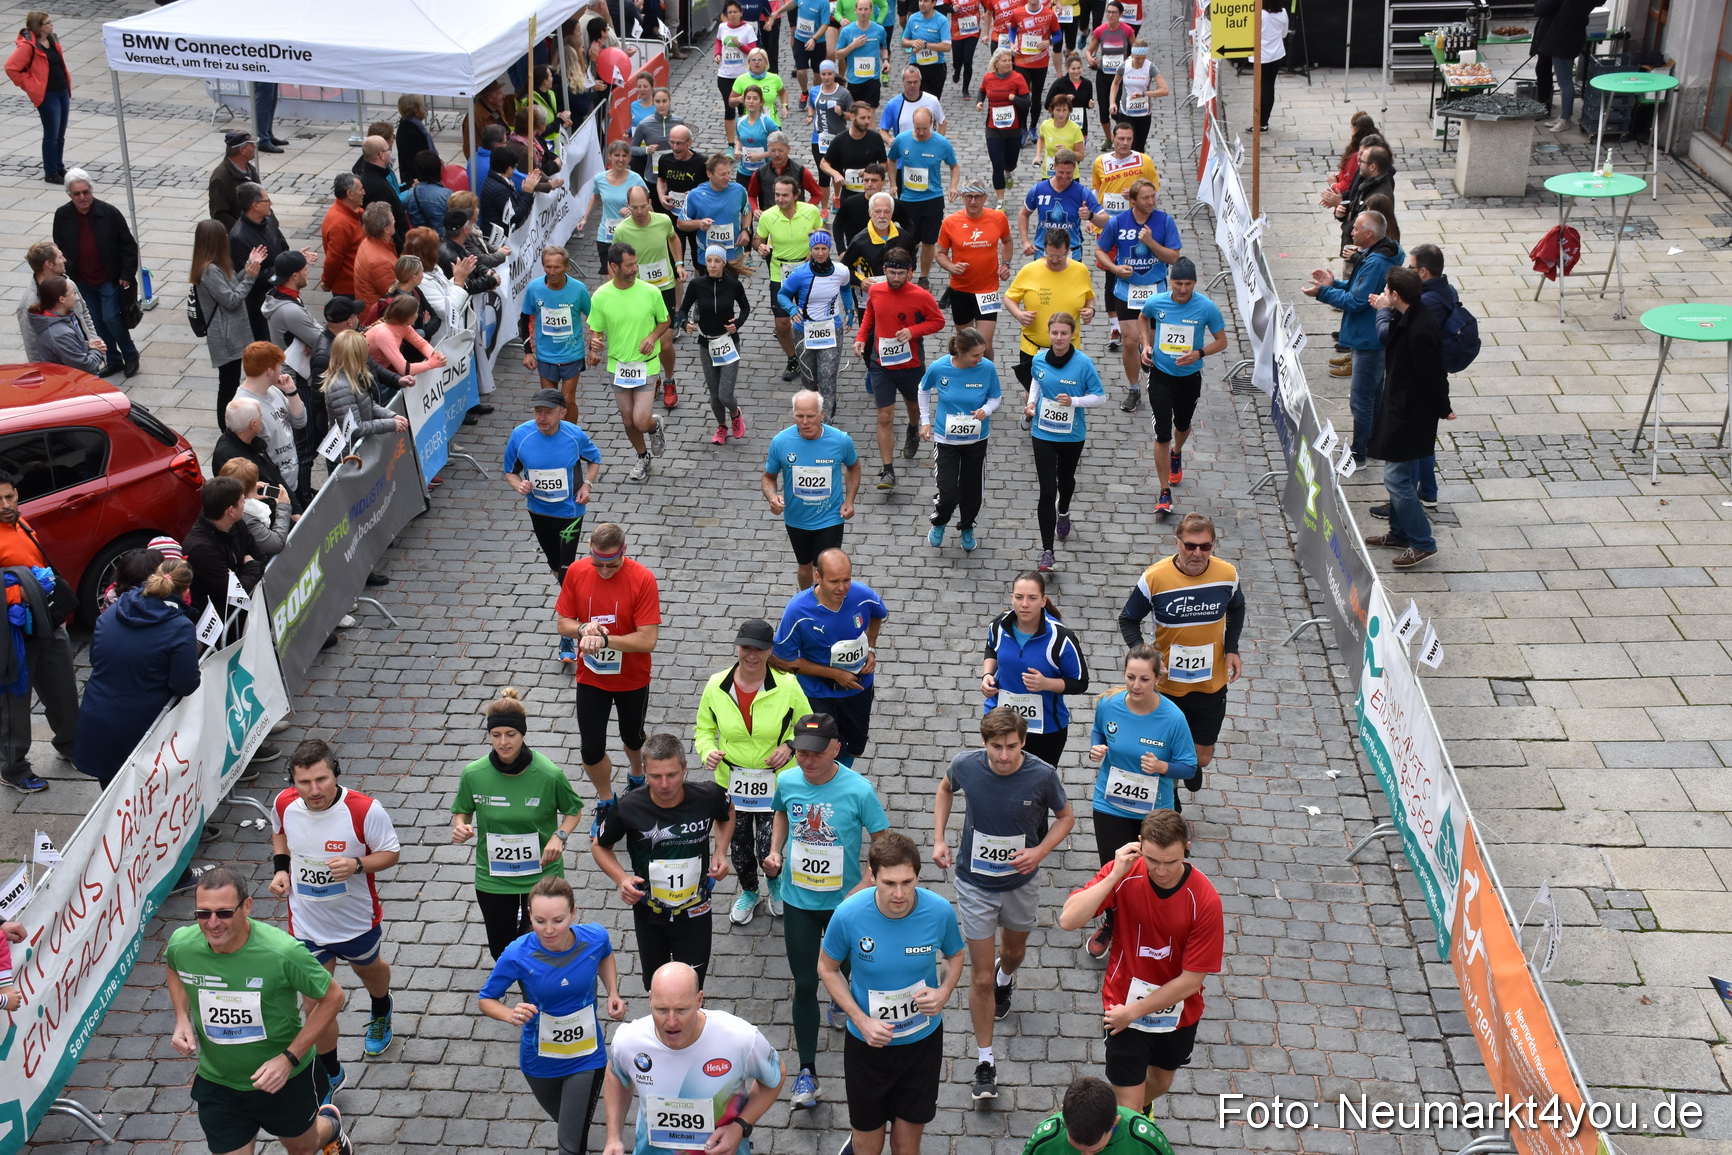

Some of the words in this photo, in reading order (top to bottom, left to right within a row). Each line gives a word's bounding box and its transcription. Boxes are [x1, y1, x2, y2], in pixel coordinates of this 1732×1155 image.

[1212, 2, 1256, 16] Jugend
[1226, 16, 1248, 28] lauf
[122, 33, 170, 50] BMW
[174, 37, 312, 62] ConnectedDrive
[124, 52, 180, 68] Vernetzt,
[182, 58, 200, 68] um
[203, 58, 222, 70] frei
[225, 62, 240, 70] zu
[242, 62, 270, 73] sein.
[909, 175, 923, 183] 408
[1104, 174, 1121, 183] MAX
[1123, 169, 1143, 181] BÖGL
[1037, 195, 1051, 206] 11
[1107, 201, 1125, 209] 2611
[710, 231, 730, 240] 2103
[1118, 229, 1136, 240] 28
[647, 269, 662, 280] 195
[546, 316, 567, 326] 2316
[809, 329, 830, 338] 2065
[1167, 333, 1185, 344] 273
[1292, 334, 1303, 349] swn
[882, 345, 904, 355] 2927
[620, 368, 641, 378] 2601
[1044, 408, 1068, 422] 2368
[950, 424, 976, 434] 2367
[325, 436, 339, 455] swn
[535, 479, 562, 489] 2559
[798, 476, 826, 487] 2022
[274, 551, 323, 642] BOCK
[1176, 602, 1221, 614] Fischer
[202, 617, 216, 639] swn
[1426, 639, 1440, 662] swn
[1176, 657, 1205, 669] 2121
[1140, 738, 1164, 747] BOCK
[734, 781, 768, 795] 2189
[1113, 782, 1149, 800] 2445
[680, 818, 711, 834] 2017
[495, 847, 532, 860] 2215
[802, 858, 830, 874] 202
[300, 868, 336, 884] 2362
[668, 874, 684, 888] 11
[0, 883, 24, 909] swn
[23, 884, 125, 1078] EINFACH
[208, 1007, 253, 1024] 2555
[879, 999, 919, 1020] 2116
[69, 976, 120, 1060] Service-Line:
[895, 1021, 914, 1029] ndreas
[552, 1026, 584, 1043] 289
[1515, 1008, 1537, 1054] Neumarkts
[706, 1063, 728, 1072] Hervis
[657, 1112, 705, 1129] 2589
